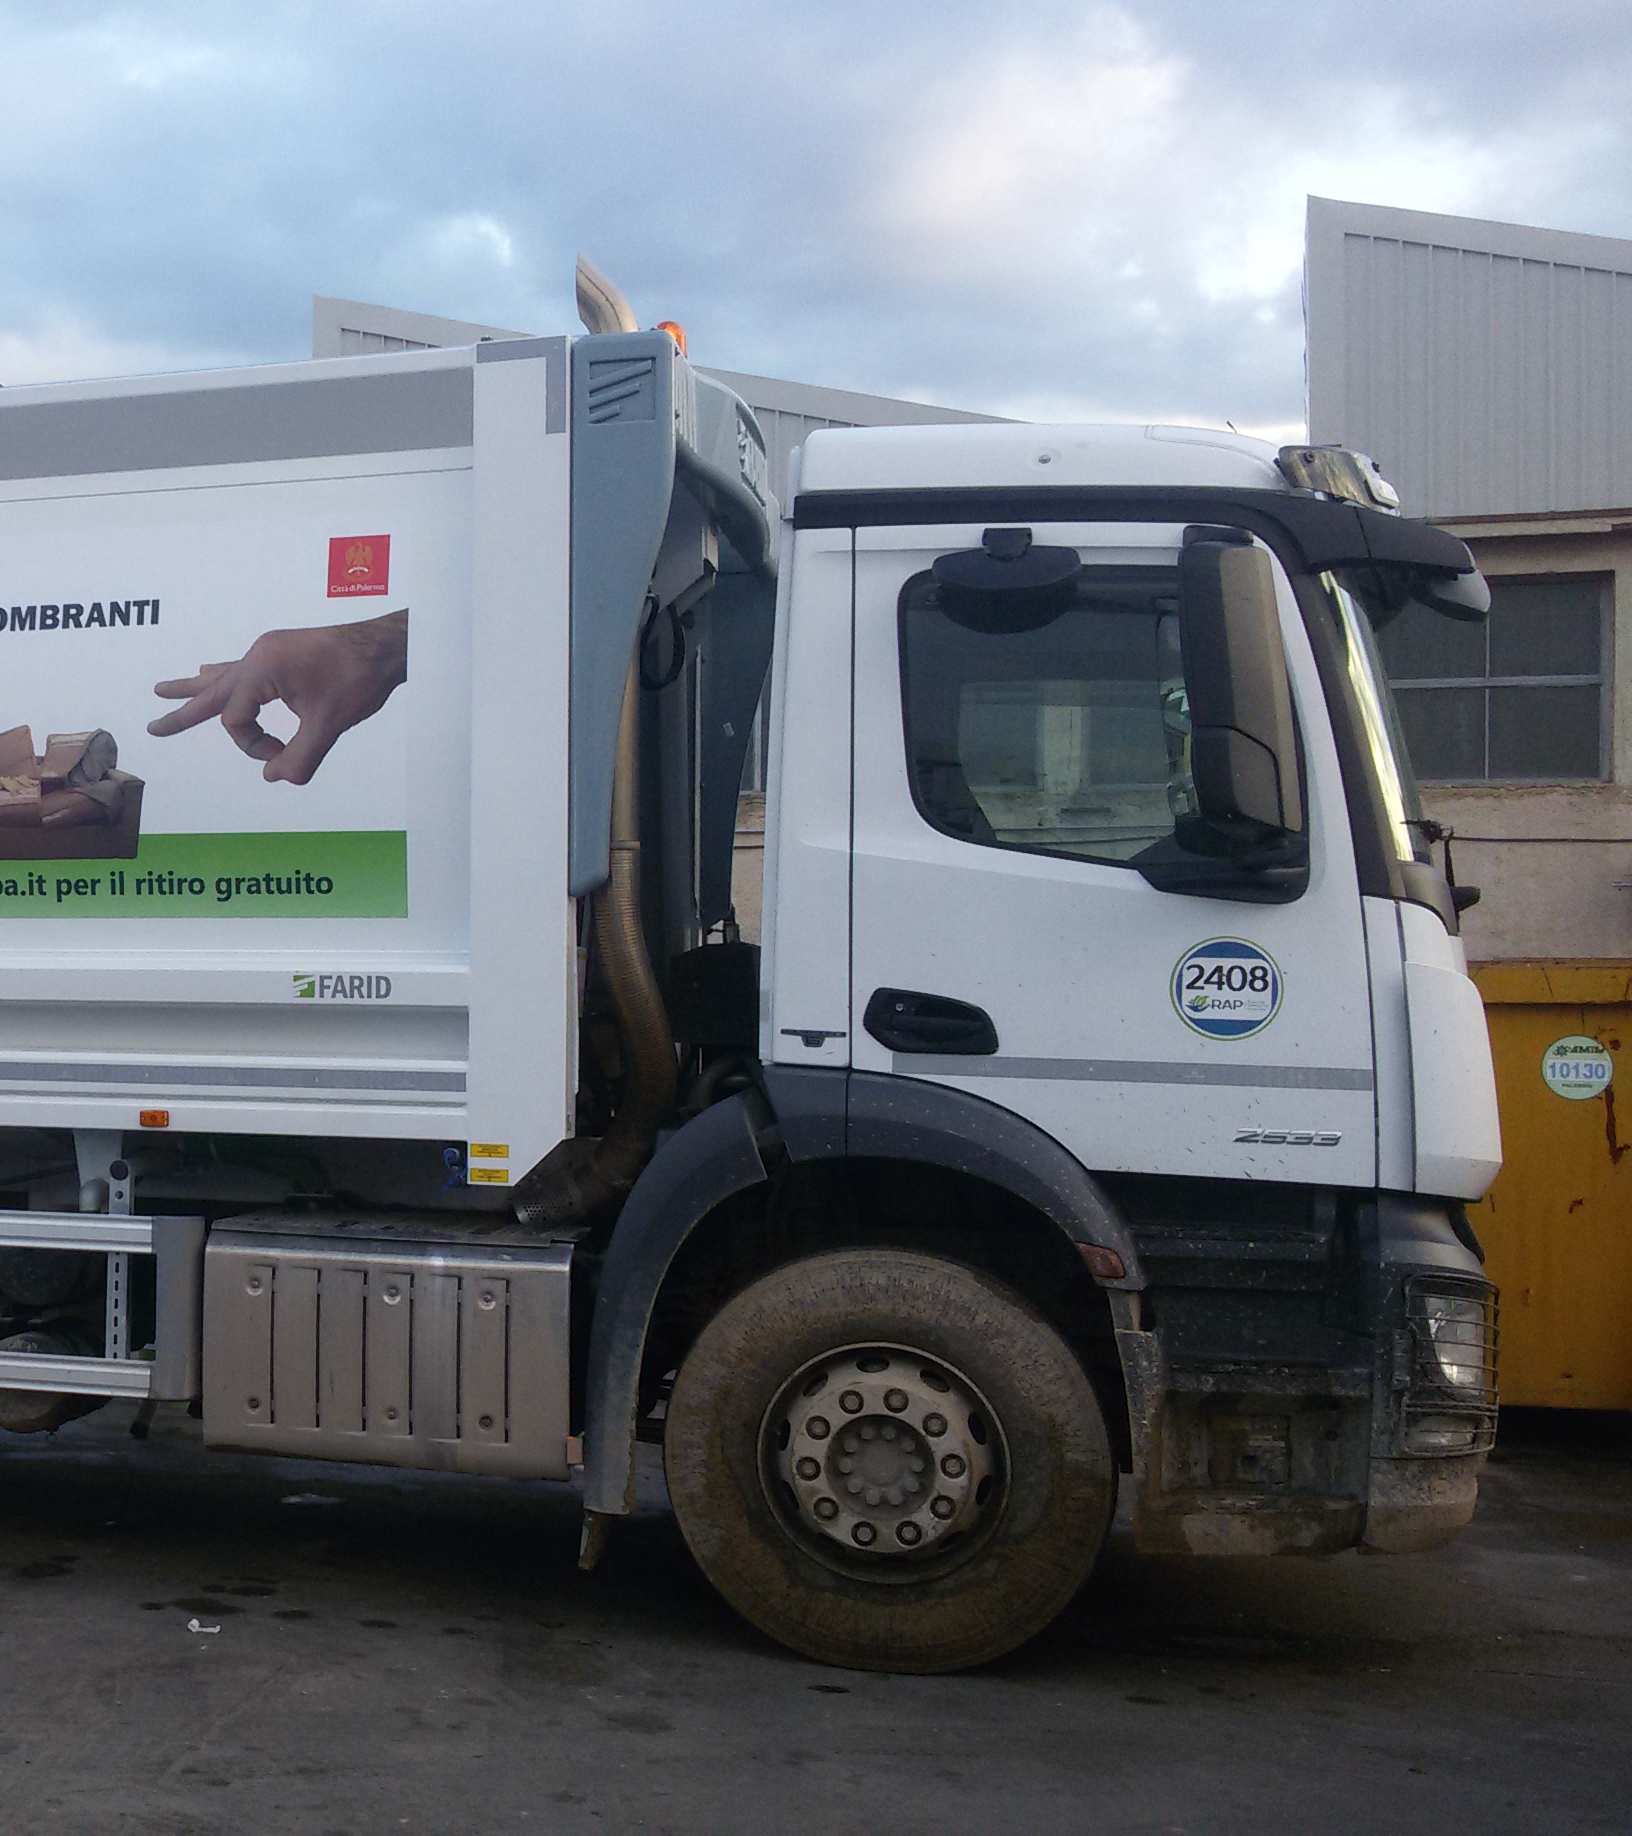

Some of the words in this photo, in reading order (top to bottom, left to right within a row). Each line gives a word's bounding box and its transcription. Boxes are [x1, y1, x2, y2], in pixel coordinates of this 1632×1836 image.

[330, 584, 349, 593] Città
[56, 877, 101, 902] per
[110, 870, 125, 895] il
[135, 870, 206, 895] ritiro
[215, 869, 334, 902] gratuito
[318, 974, 392, 999] FARID
[1185, 964, 1269, 992] 2408
[1211, 999, 1244, 1010] RAP
[1548, 1061, 1606, 1079] 10130
[1233, 1128, 1343, 1147] 2533
